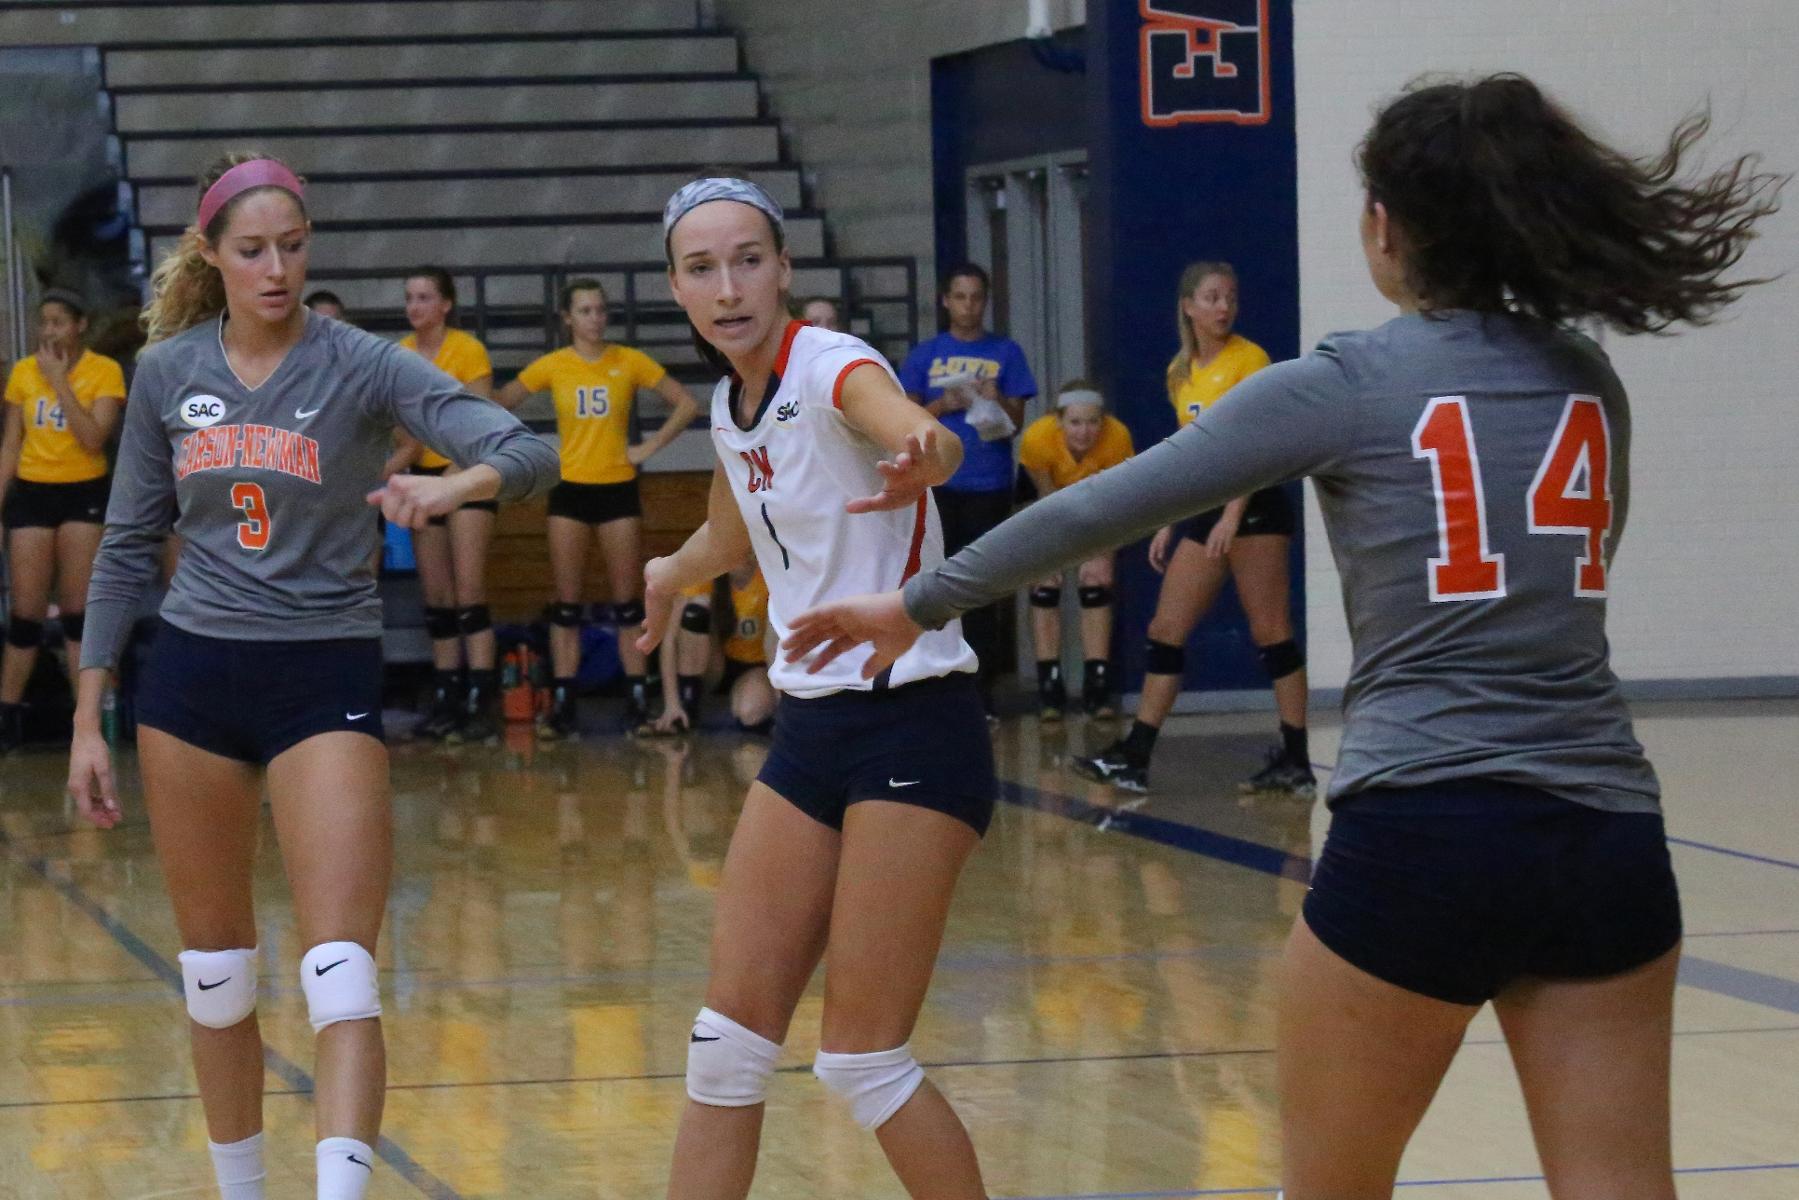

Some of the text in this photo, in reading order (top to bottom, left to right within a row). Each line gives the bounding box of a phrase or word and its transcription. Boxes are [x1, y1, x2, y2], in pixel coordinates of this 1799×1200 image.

[35, 397, 66, 431] 14
[187, 403, 221, 419] SAC
[576, 386, 609, 419] 15
[1410, 394, 1614, 603] 14
[230, 482, 272, 550] 3
